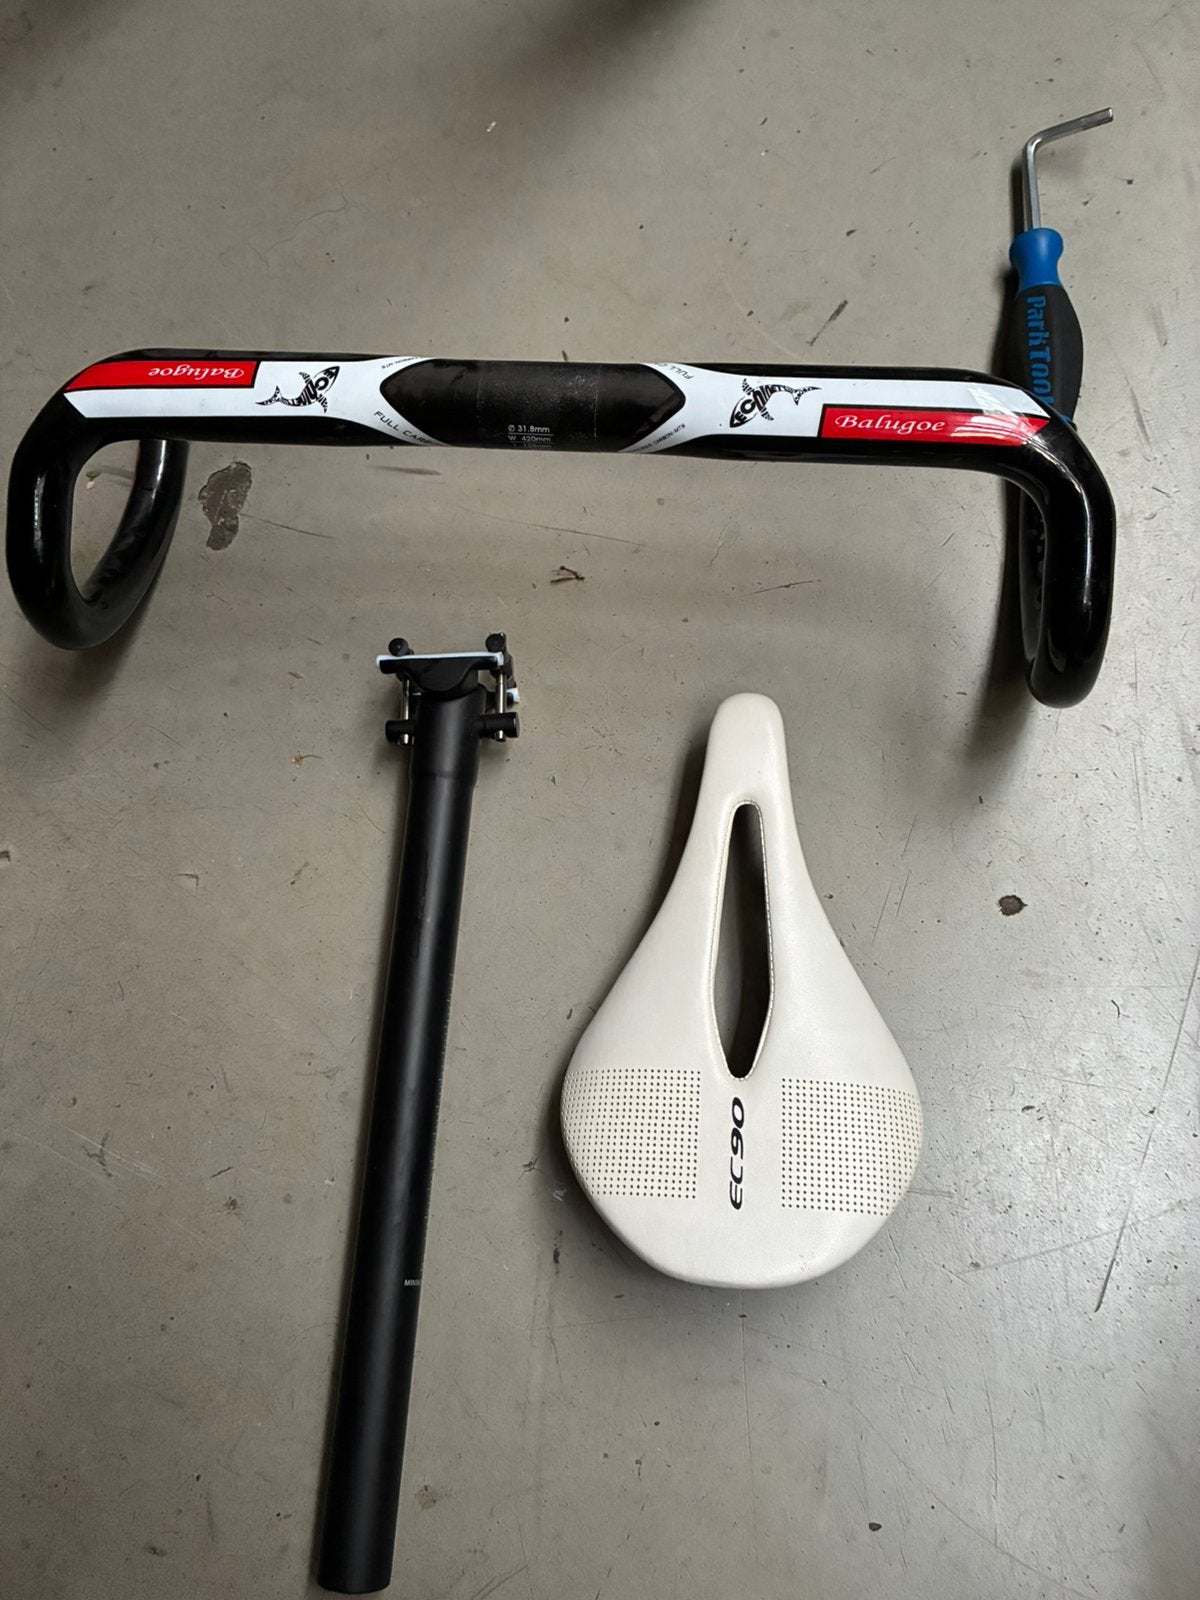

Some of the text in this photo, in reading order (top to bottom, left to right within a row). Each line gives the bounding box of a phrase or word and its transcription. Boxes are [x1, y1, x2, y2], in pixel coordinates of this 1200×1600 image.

[147, 363, 245, 381] Balugoe
[373, 410, 400, 432] FULL
[517, 424, 551, 433] 31.8mm
[834, 413, 946, 435] Balugoe
[729, 1096, 745, 1211] EC90
